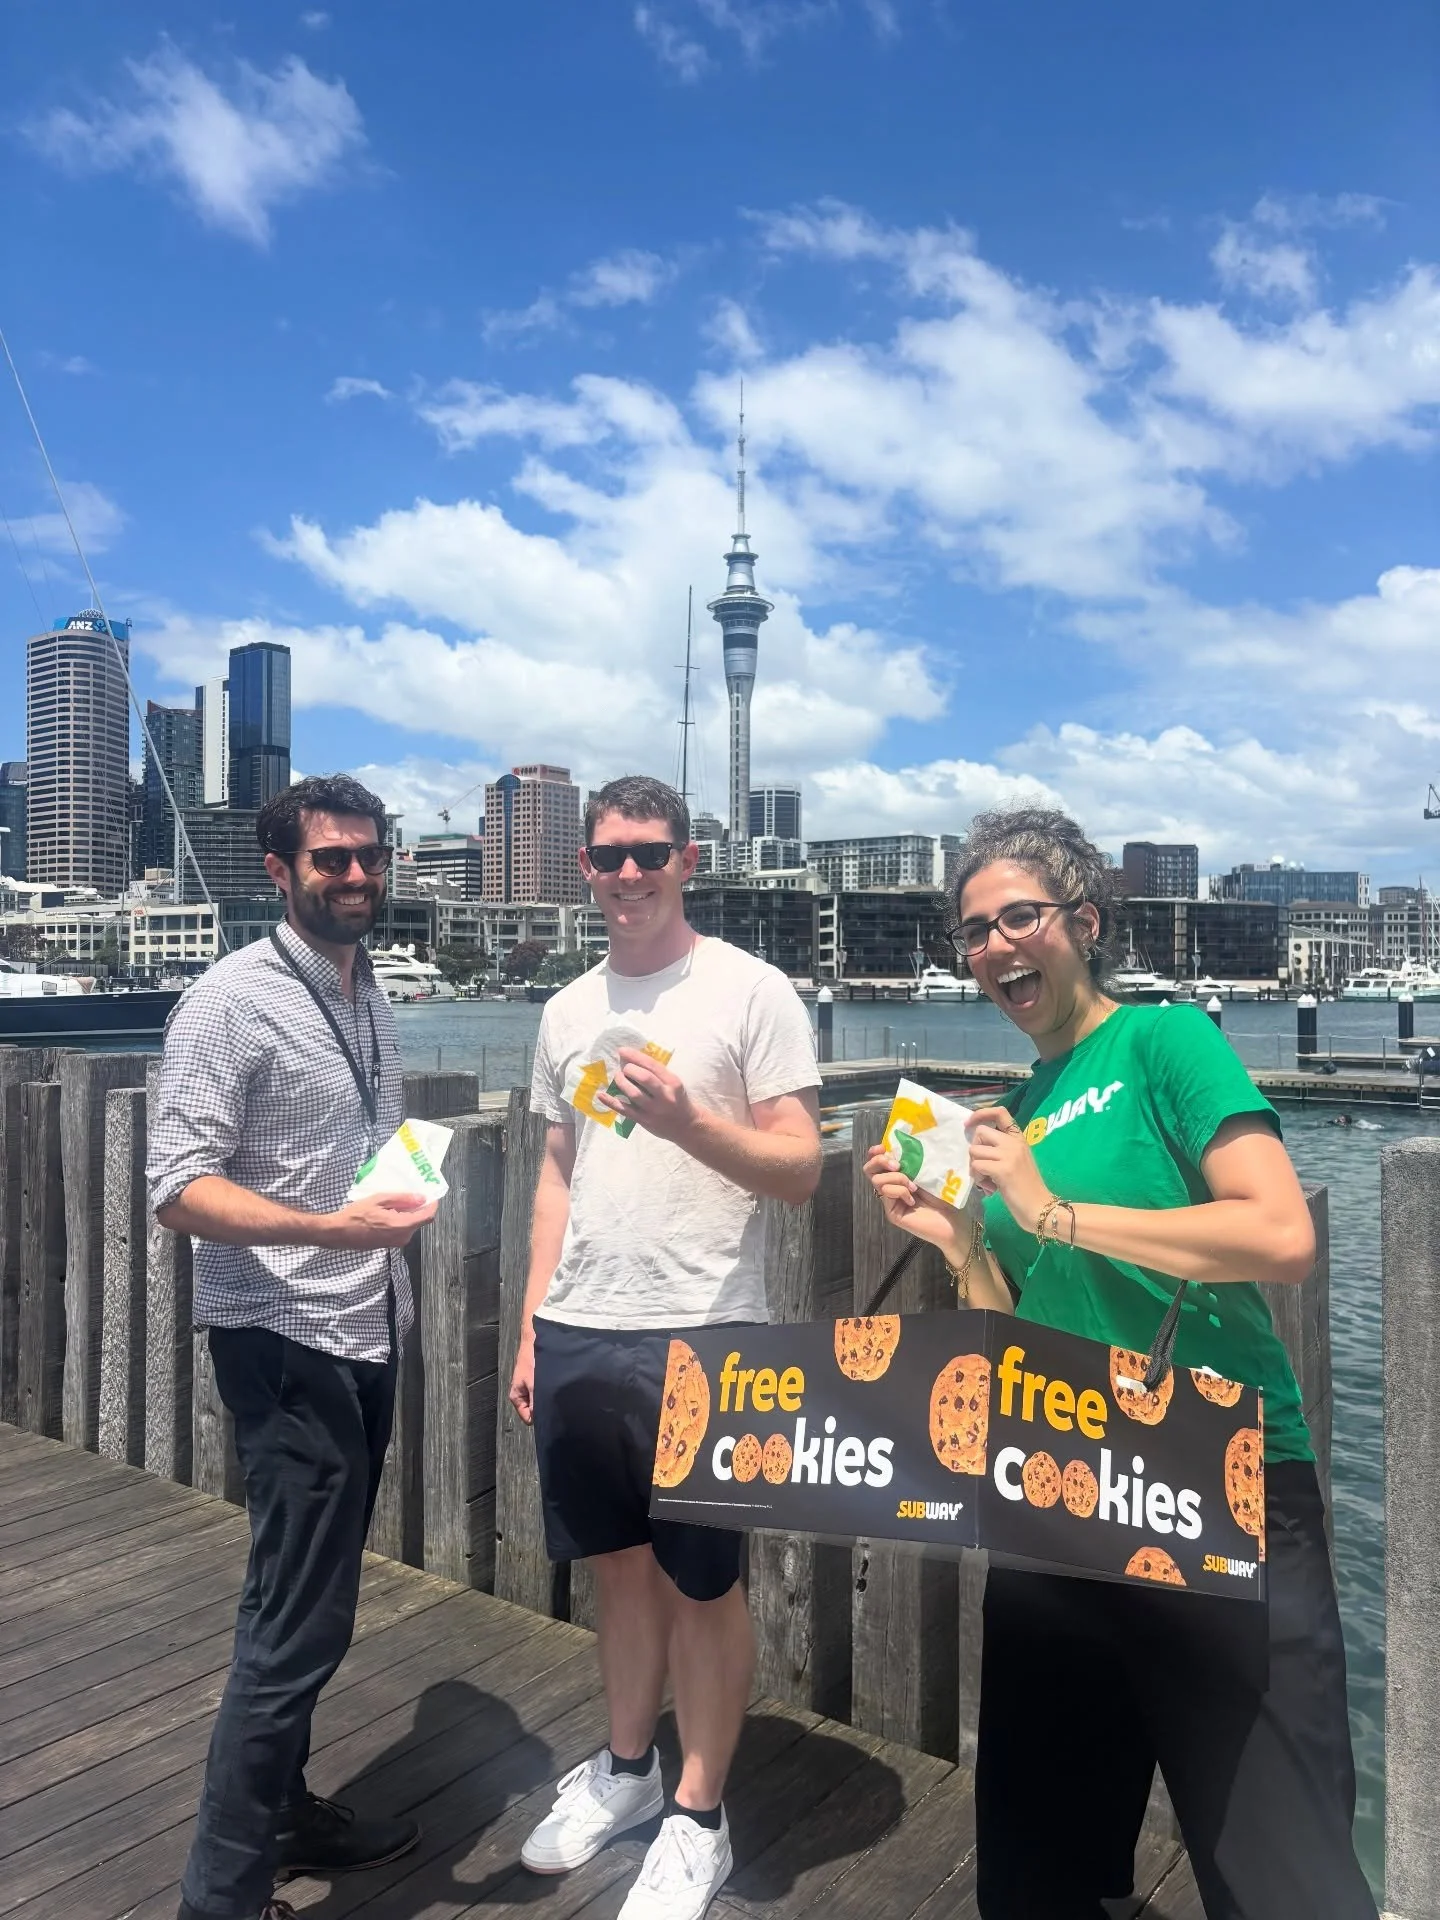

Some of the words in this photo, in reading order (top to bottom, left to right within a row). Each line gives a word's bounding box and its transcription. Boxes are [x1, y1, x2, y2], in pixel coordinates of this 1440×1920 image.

[67, 620, 93, 631] ANZ
[719, 1351, 805, 1412] free
[997, 1345, 1107, 1439] free
[712, 1415, 894, 1487] cookies
[896, 1500, 964, 1521] SUBWAY
[993, 1446, 1203, 1540] cookies
[1202, 1554, 1258, 1579] SUBWAY
